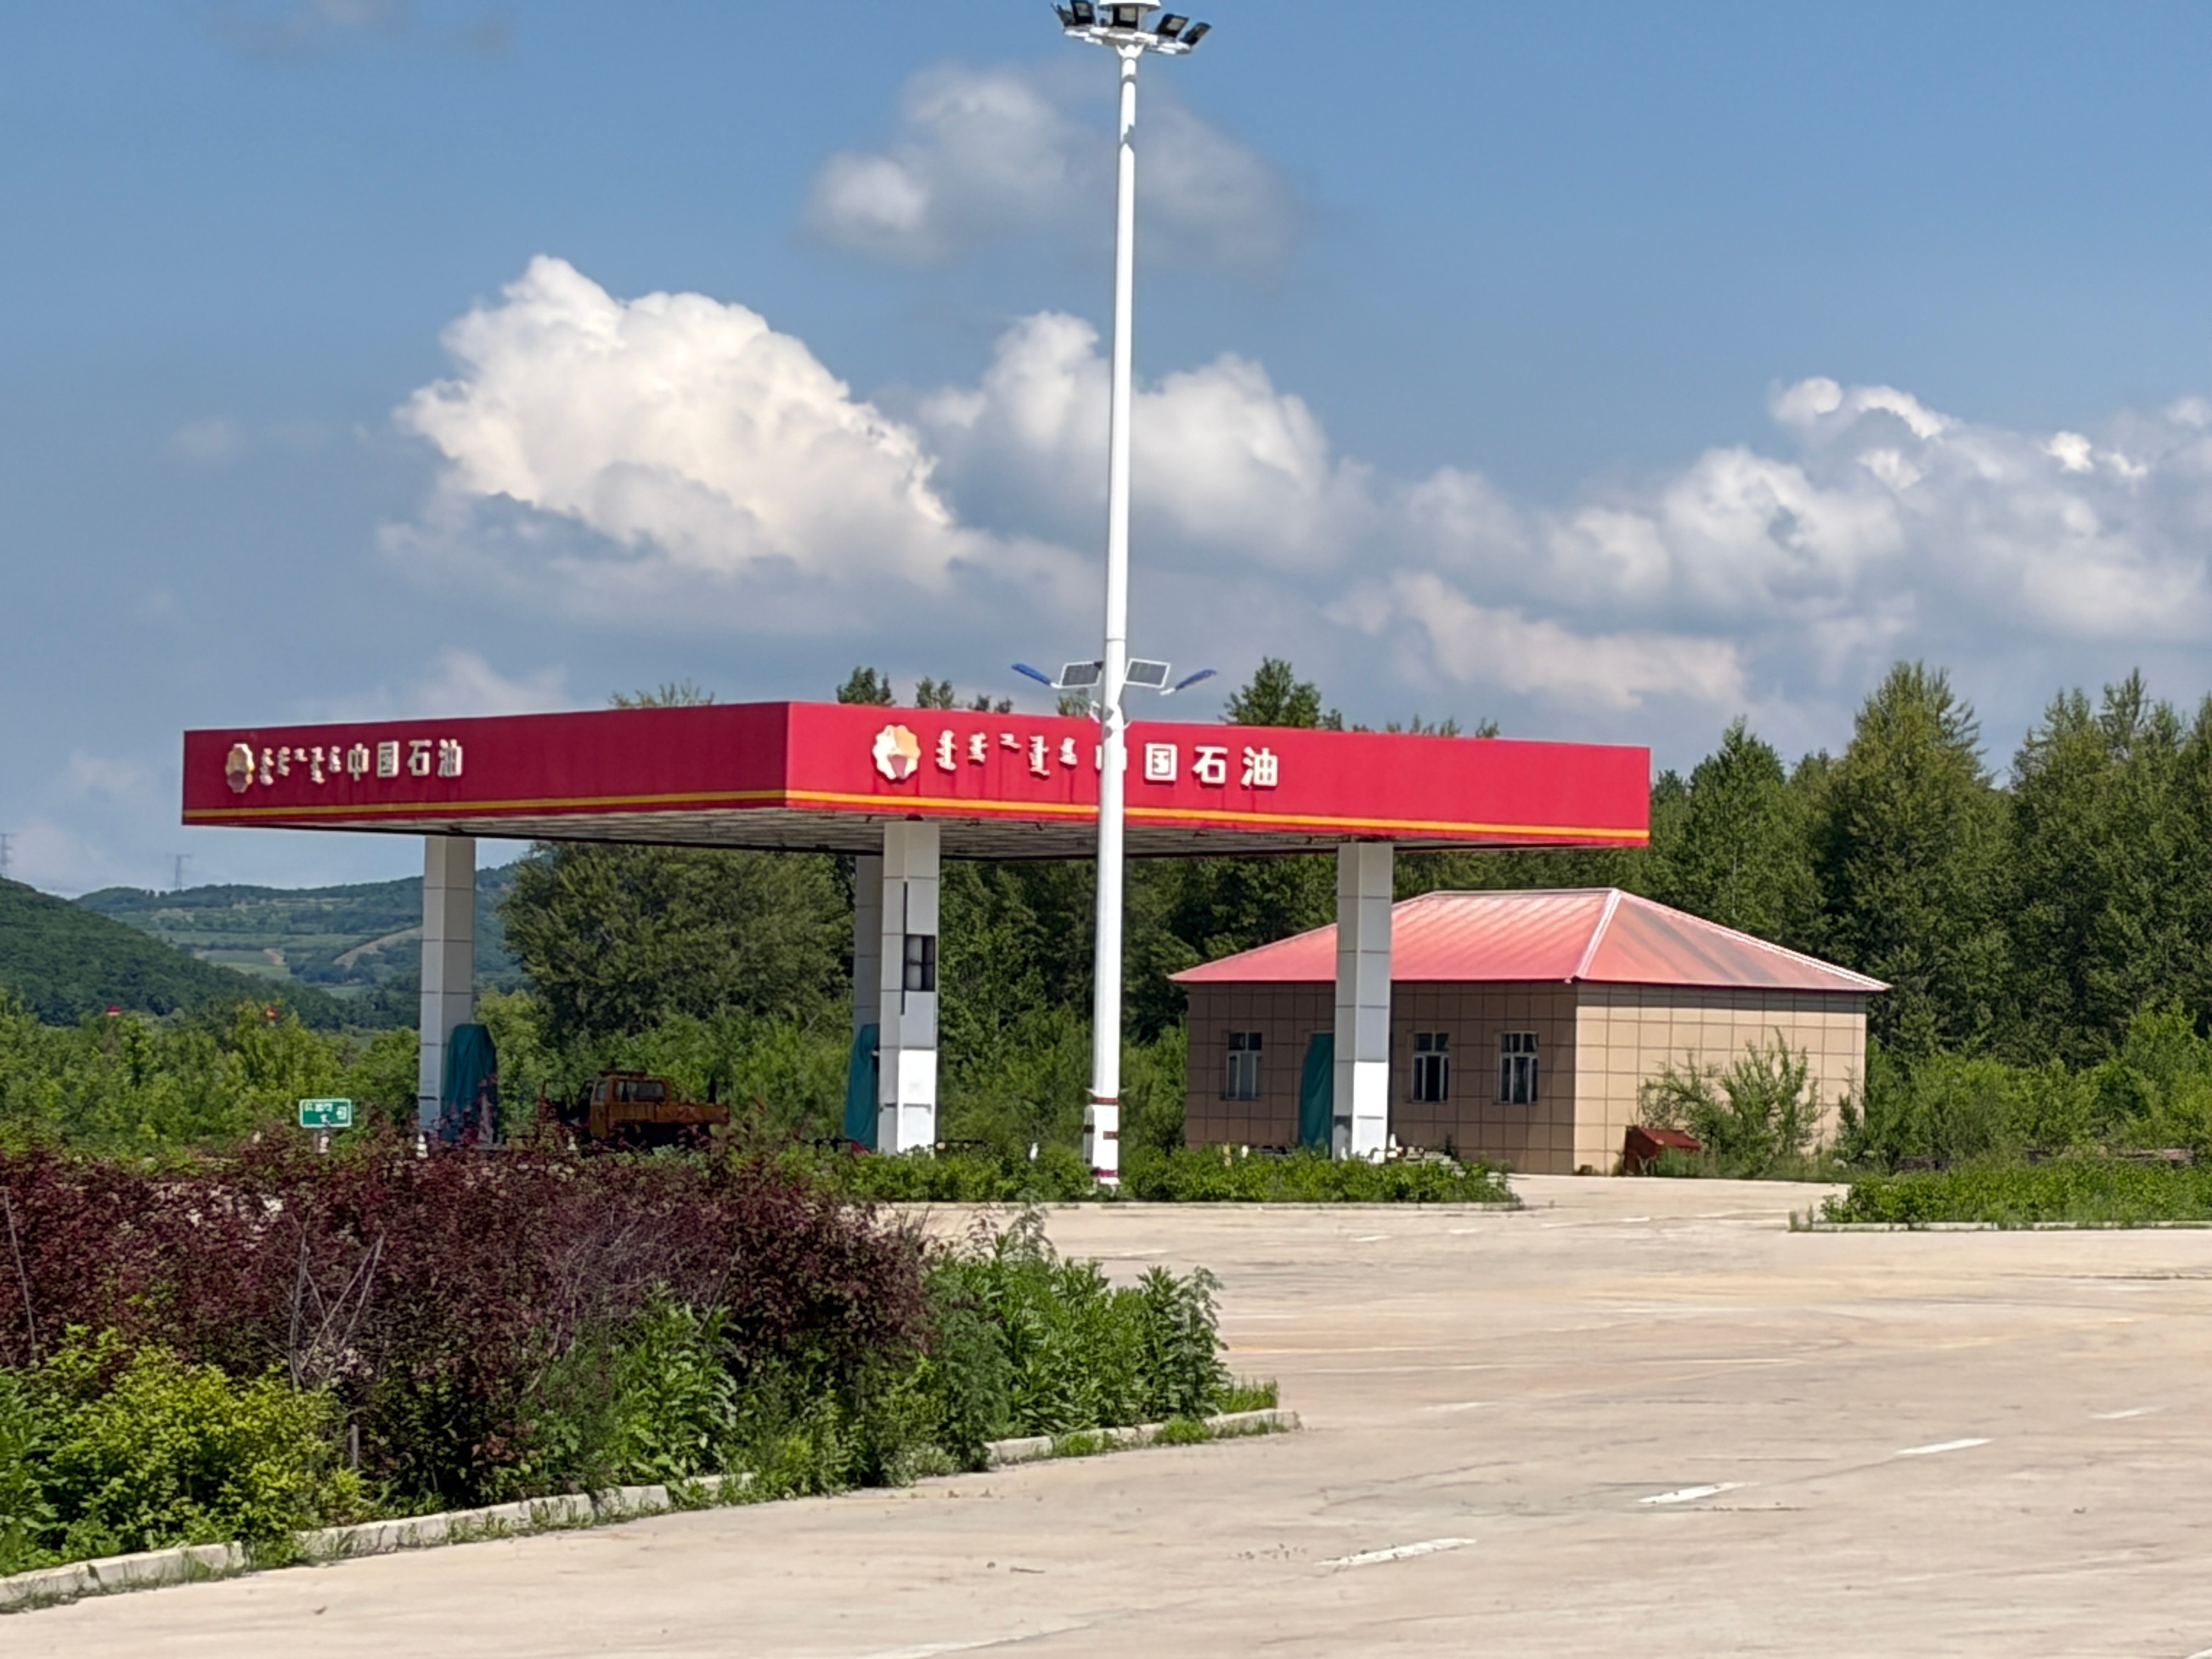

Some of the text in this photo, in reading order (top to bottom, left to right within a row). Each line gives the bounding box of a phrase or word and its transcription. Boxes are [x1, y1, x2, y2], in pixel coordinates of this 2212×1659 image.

[347, 739, 463, 782] 中国石油
[1096, 742, 1278, 787] 国石油
